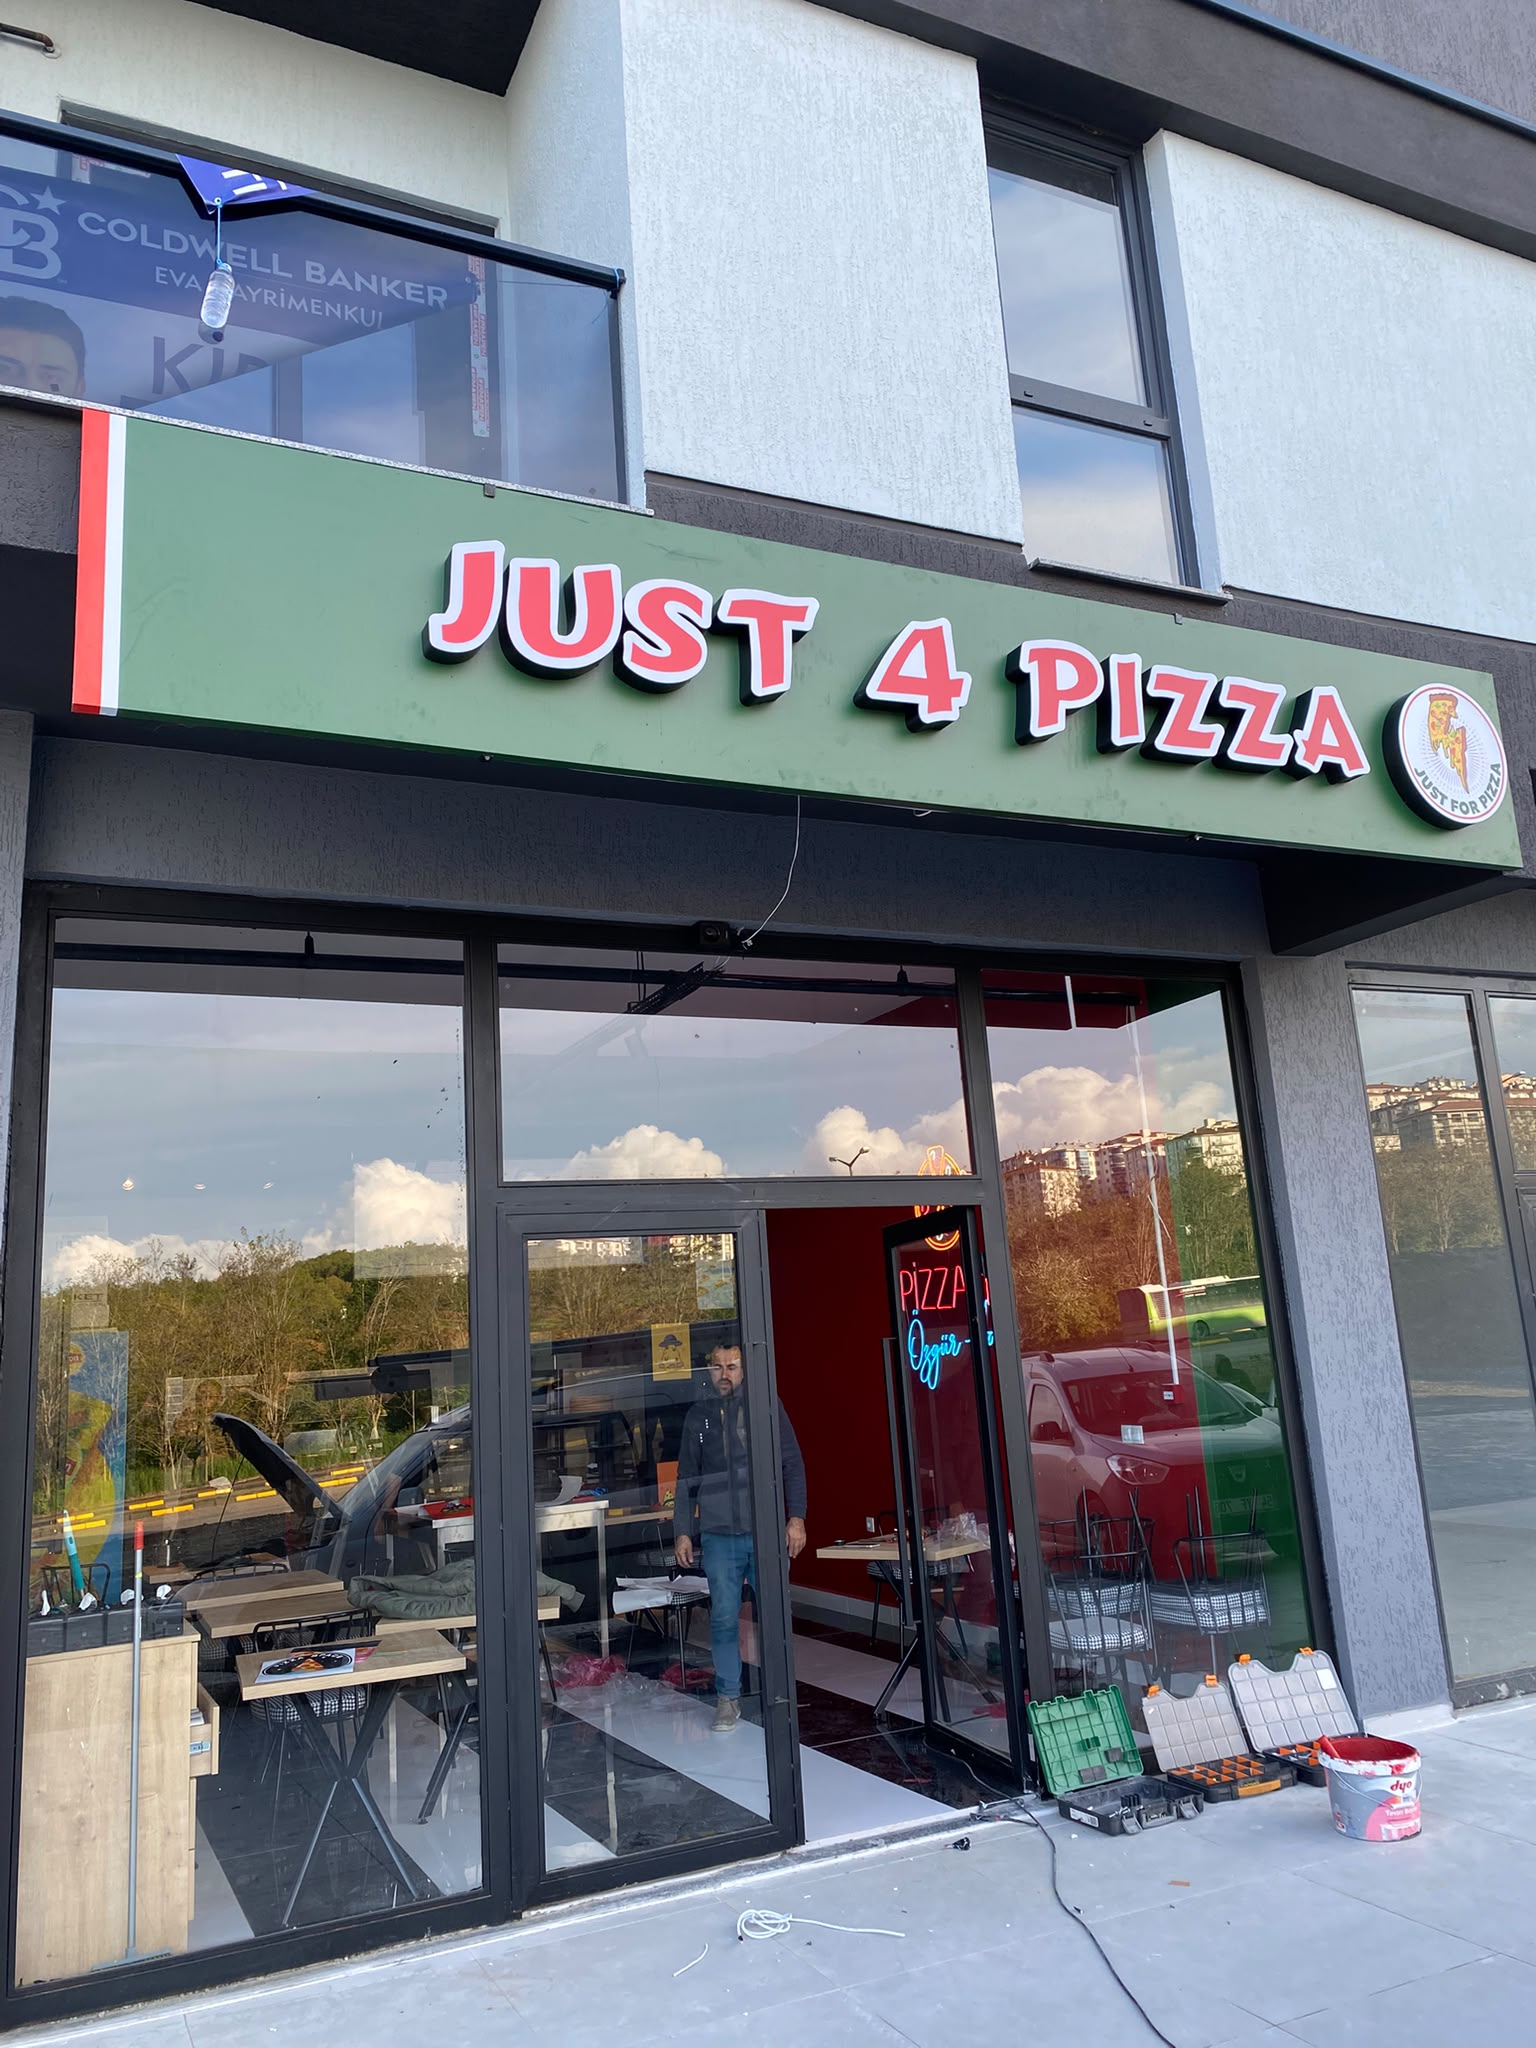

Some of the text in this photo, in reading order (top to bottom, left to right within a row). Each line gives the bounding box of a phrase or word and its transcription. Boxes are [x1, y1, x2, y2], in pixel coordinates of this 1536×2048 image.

[78, 211, 448, 311] COLDWELL BANKER
[155, 265, 203, 292] EVA
[424, 540, 1370, 782] JUST 4 PIZZA
[1414, 763, 1502, 816] JUST FOR PIZZA
[1390, 1780, 1412, 1793] dyo
